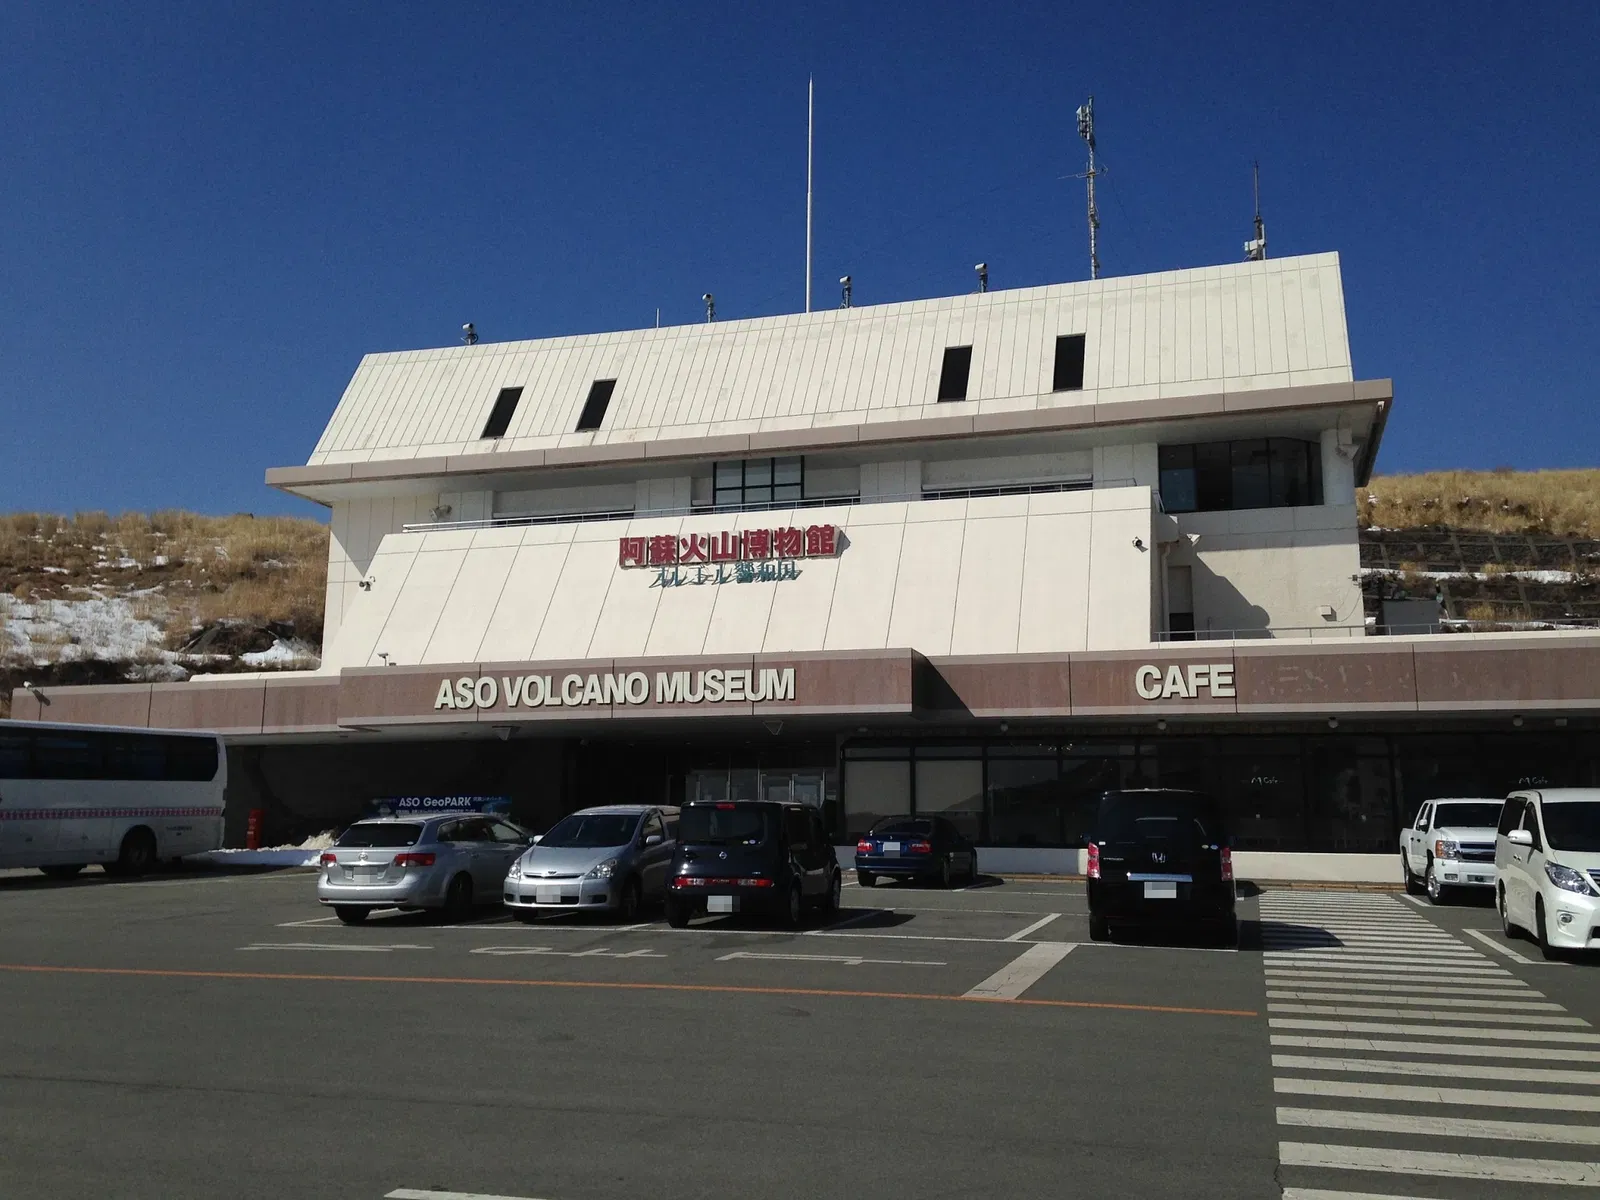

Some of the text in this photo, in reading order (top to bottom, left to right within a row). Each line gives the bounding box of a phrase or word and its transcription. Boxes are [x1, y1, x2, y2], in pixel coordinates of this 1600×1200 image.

[619, 524, 837, 566] 阿蘇火山博物館
[434, 668, 796, 709] ASO VOLCANO MUSEUM
[1135, 664, 1237, 699] CAFE
[399, 797, 421, 807] ASO
[423, 796, 472, 807] GeoPARK
